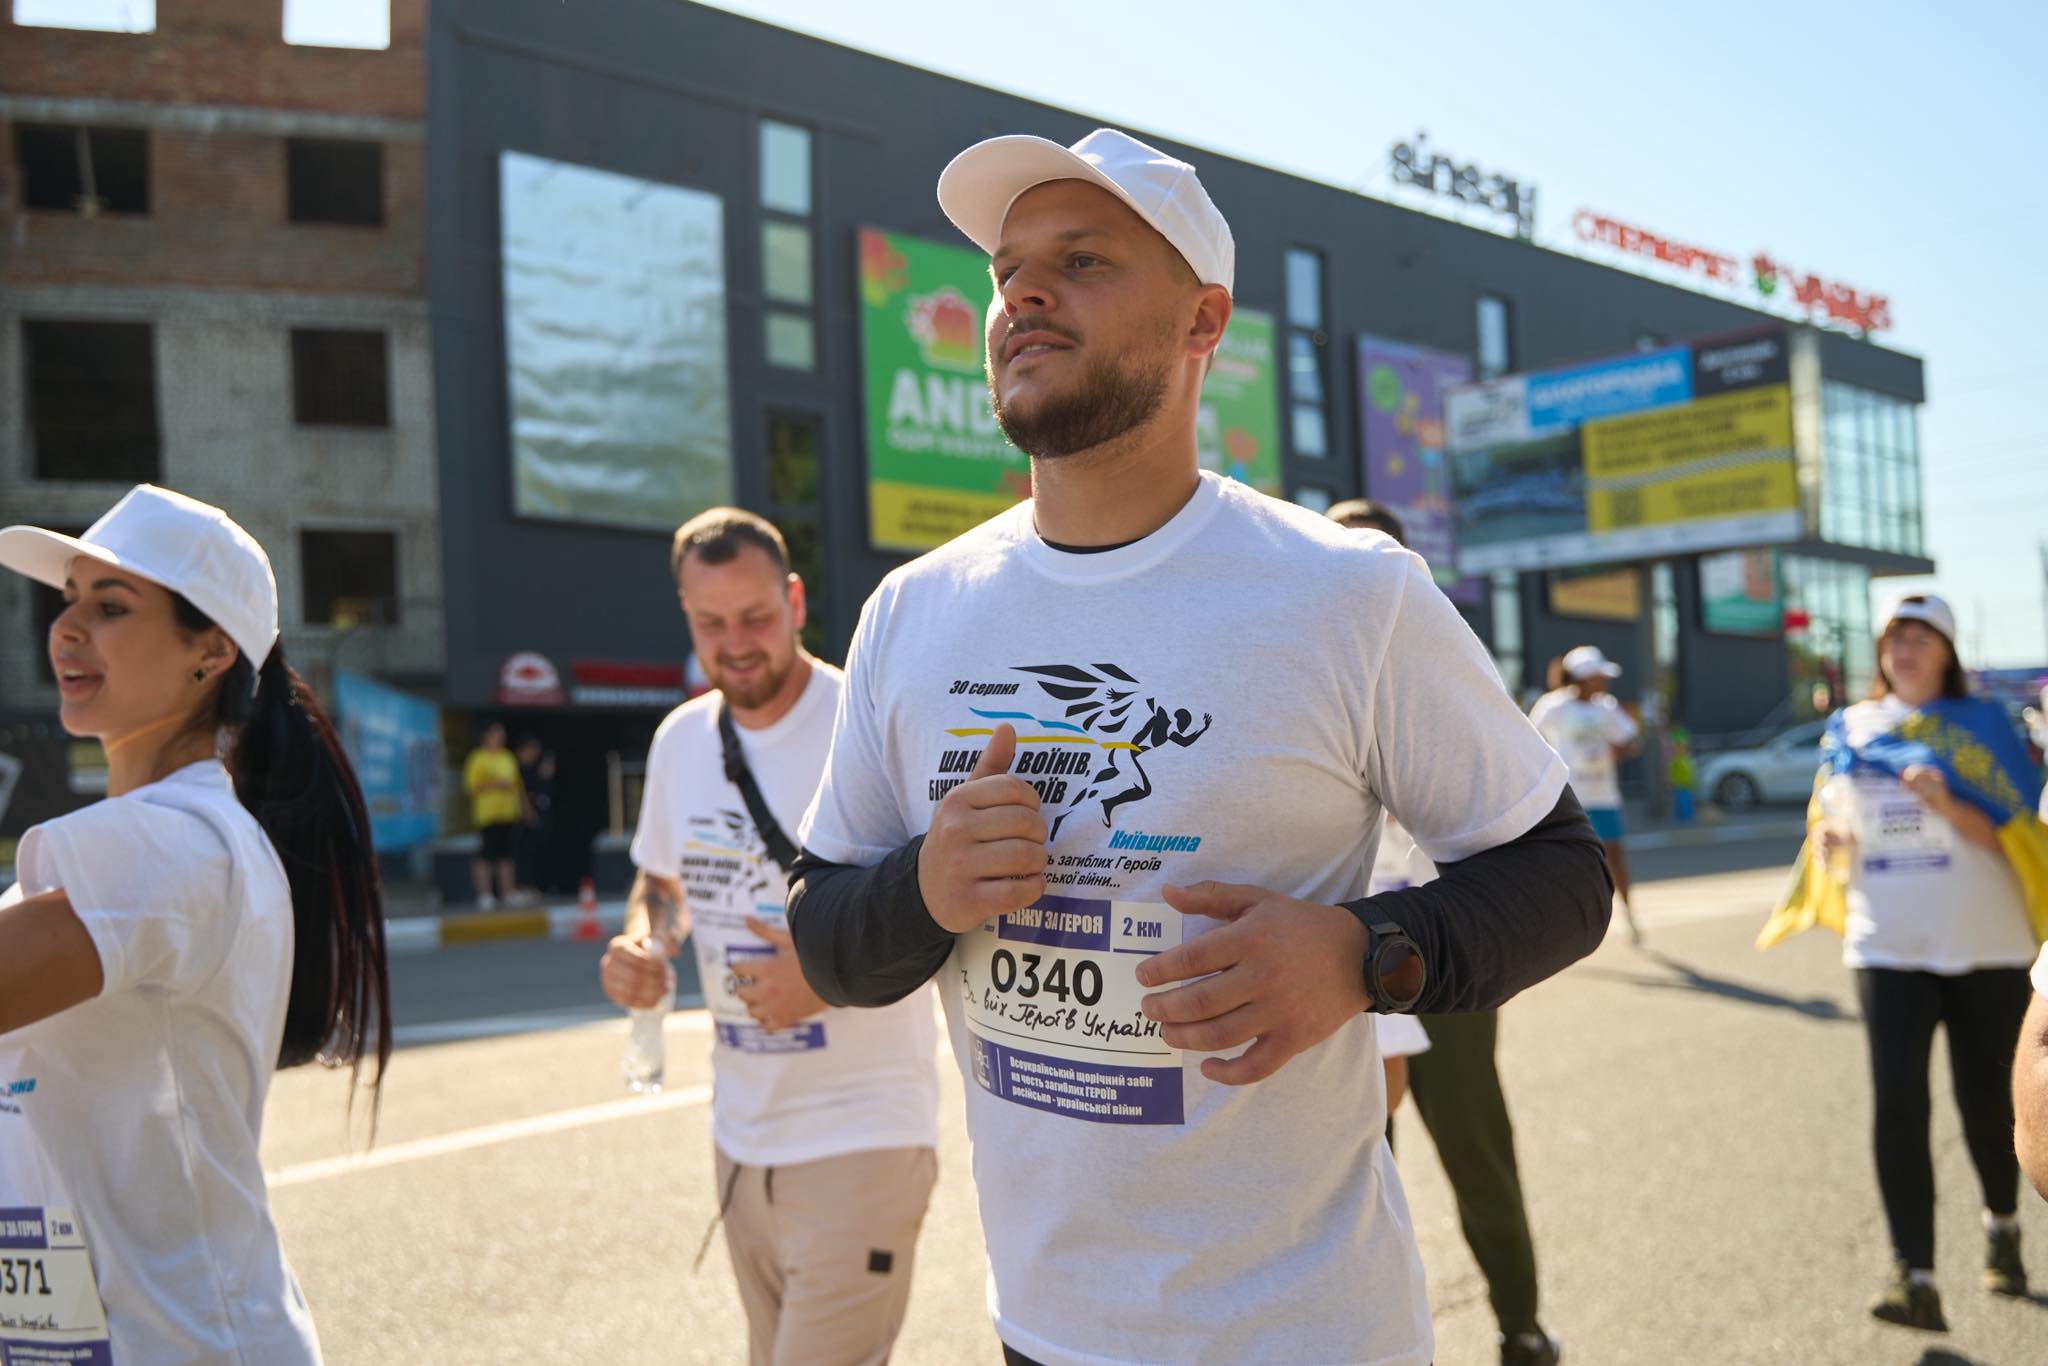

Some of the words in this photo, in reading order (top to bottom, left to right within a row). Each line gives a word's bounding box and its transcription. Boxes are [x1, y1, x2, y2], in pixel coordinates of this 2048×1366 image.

[949, 680, 969, 694] 30
[969, 682, 1020, 697] серпня
[1015, 747, 1091, 777] ВОЇНІВ,
[1108, 829, 1202, 853] Київщина
[1058, 854, 1114, 869] загиблих
[1115, 855, 1162, 873] Героїв
[1058, 914, 1103, 934] ГЕРОЯ
[1122, 917, 1132, 936] 2
[991, 949, 1103, 1007] 0340
[1010, 1056, 1075, 1080] Всеукраїнський
[1076, 1070, 1125, 1087] щорічний
[1127, 1074, 1153, 1088] забіг
[1011, 1072, 1020, 1082] на
[1045, 1079, 1085, 1097] загиблих
[1085, 1086, 1118, 1101] ГЕРОЇВ
[1112, 1103, 1143, 1116] війни
[0, 1257, 52, 1296] 371
